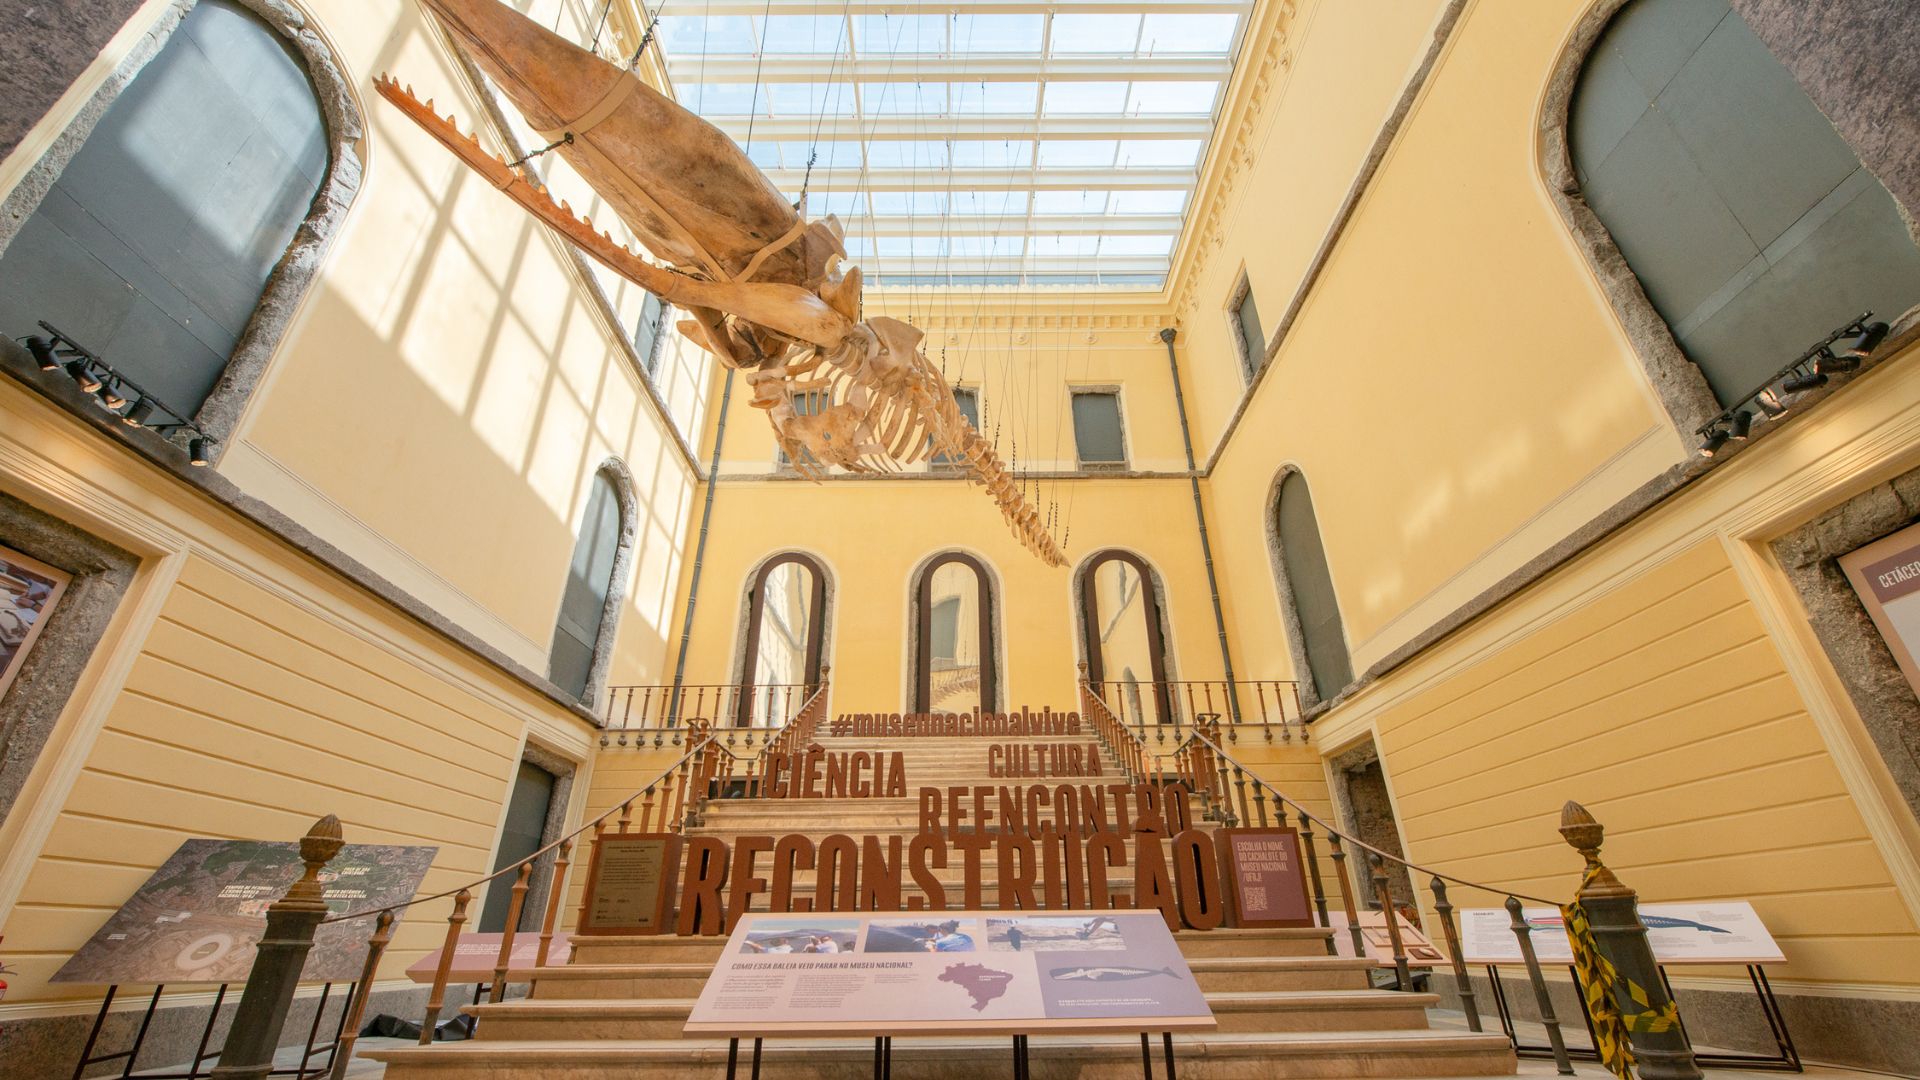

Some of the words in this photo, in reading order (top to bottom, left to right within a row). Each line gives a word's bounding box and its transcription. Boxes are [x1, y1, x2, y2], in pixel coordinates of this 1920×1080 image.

[830, 705, 1081, 738] #museunacionalvive
[766, 743, 907, 799] CIÊNCIA
[988, 744, 1103, 778] CULTURA
[919, 783, 1193, 840] REENCONTRO
[676, 816, 1224, 937] RECONSTRUÇÃO
[875, 961, 913, 969] NACIONAL?
